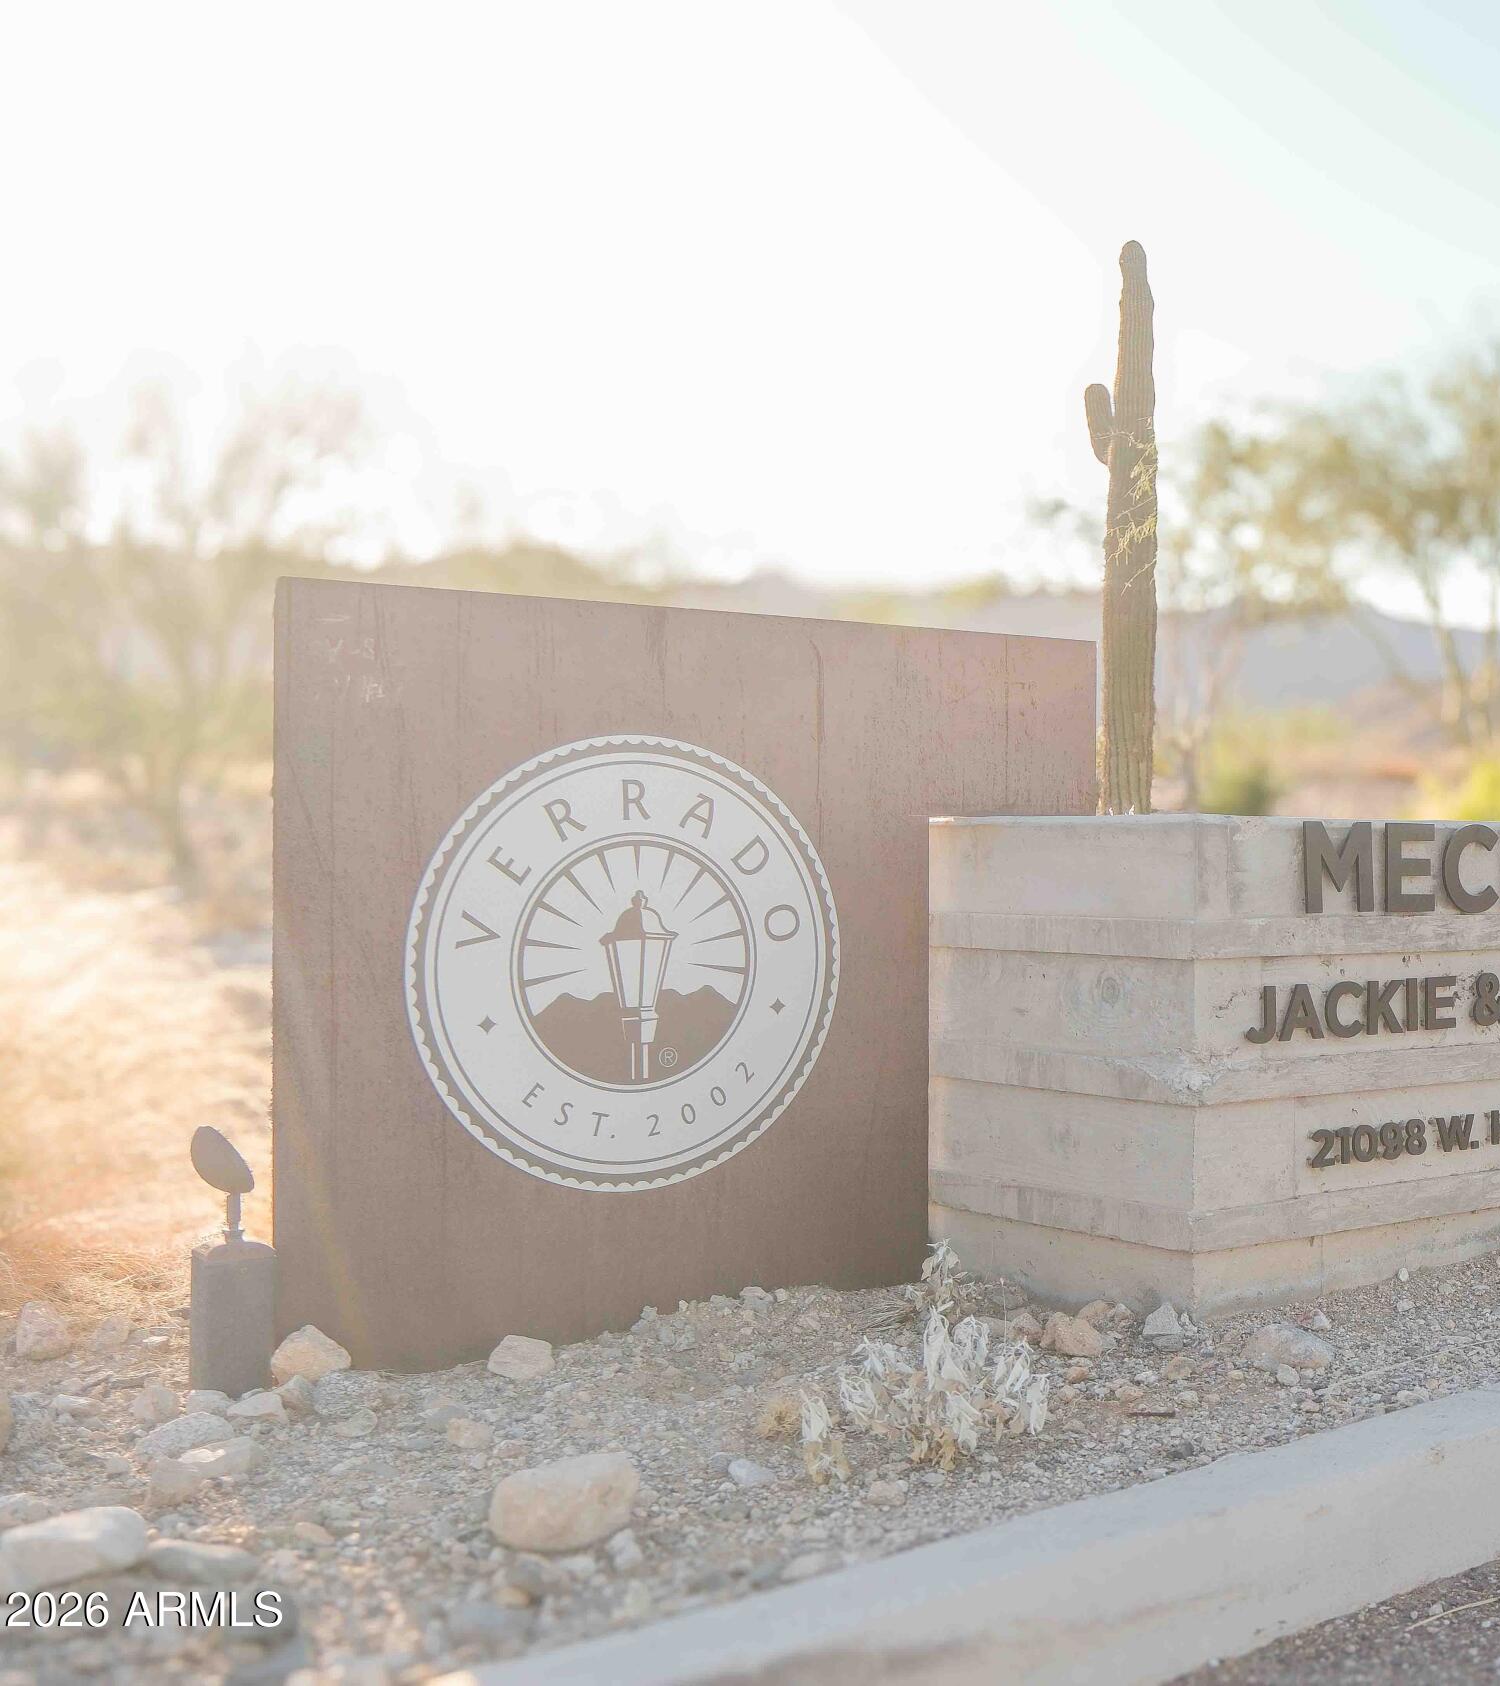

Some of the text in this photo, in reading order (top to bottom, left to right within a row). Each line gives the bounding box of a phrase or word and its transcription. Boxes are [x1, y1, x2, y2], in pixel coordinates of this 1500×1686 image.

[455, 778, 801, 949] VERRADO
[1245, 975, 1457, 1044] JACKIE
[521, 1061, 756, 1140] EST. 2002
[1307, 1118, 1428, 1169] 21098
[1434, 1113, 1480, 1152] W.
